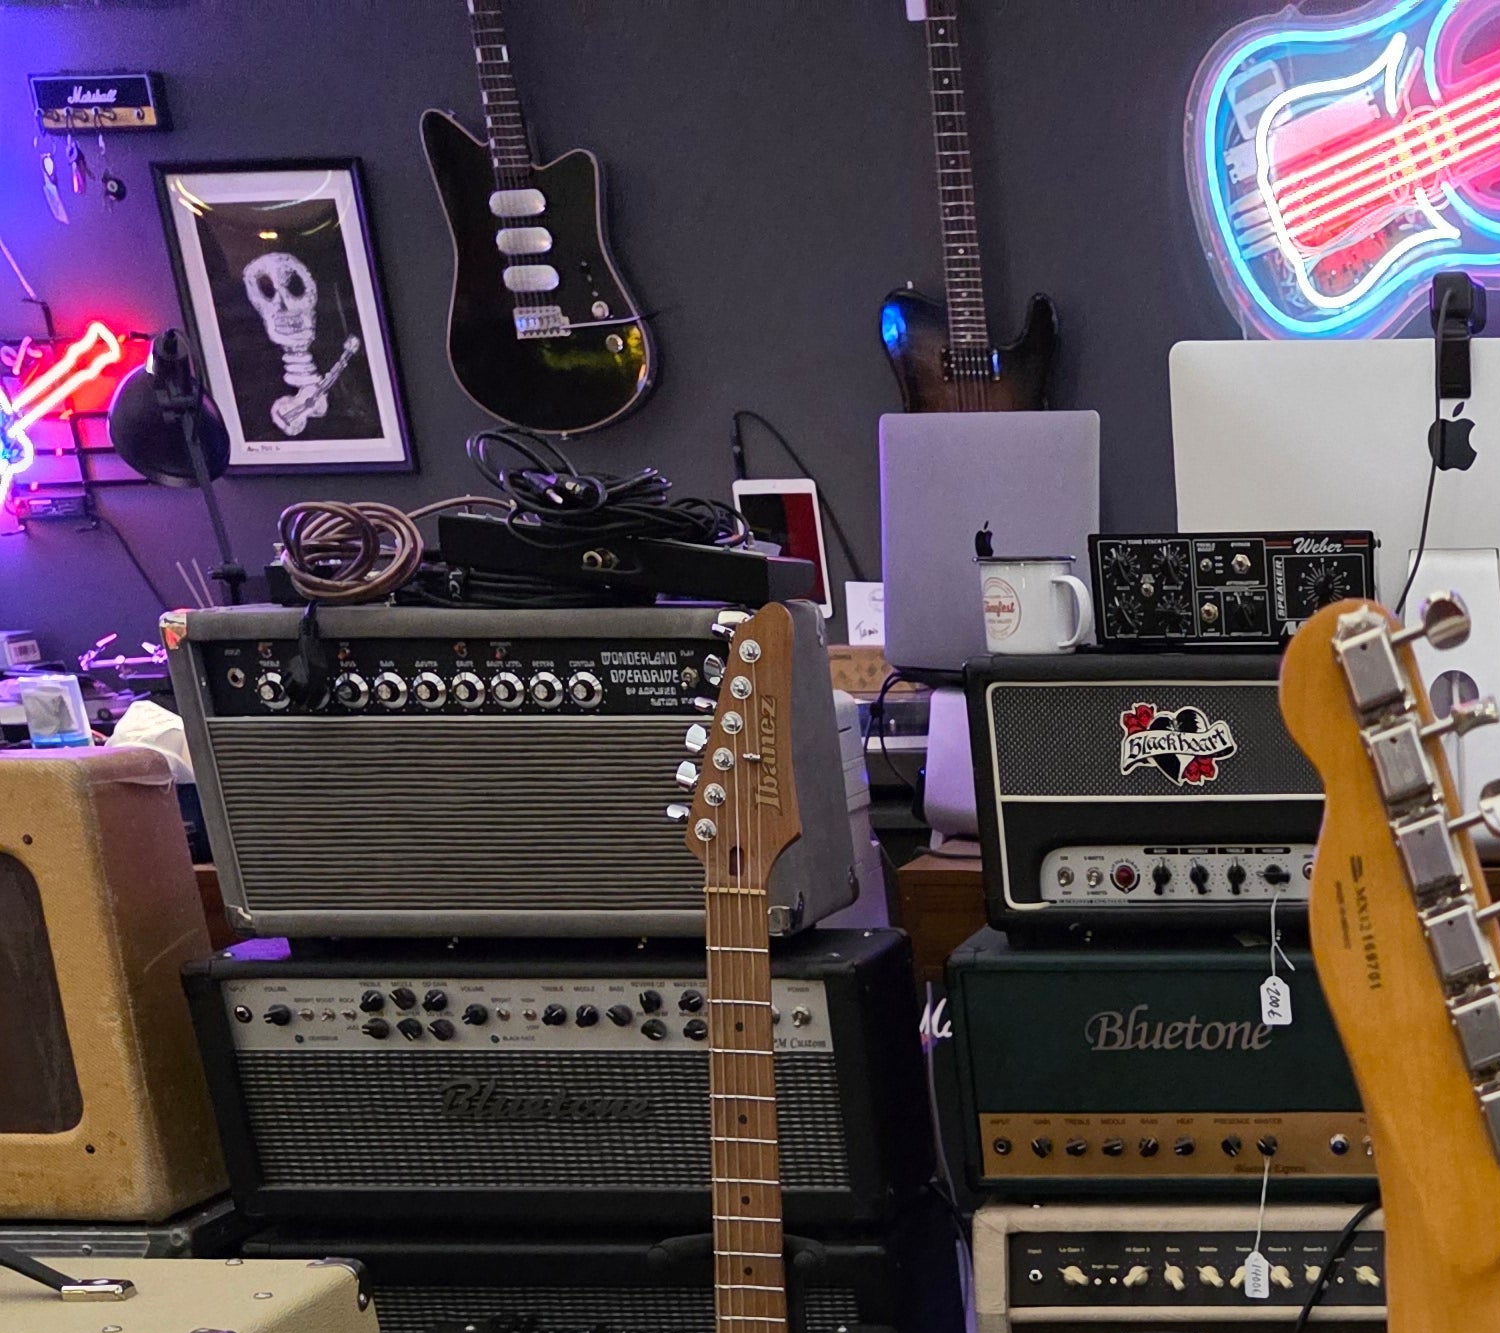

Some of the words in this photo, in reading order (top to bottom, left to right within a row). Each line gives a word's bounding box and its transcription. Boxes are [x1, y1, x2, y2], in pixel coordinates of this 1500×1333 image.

[1293, 537, 1344, 554] Weber
[1275, 560, 1286, 617] SPEAKER
[600, 651, 678, 666] WONDERLAND
[610, 669, 680, 683] OVERDRIVE
[754, 694, 783, 817] Ibanez
[1128, 728, 1227, 759] Blackheart
[1084, 1003, 1273, 1051] Bluetone
[437, 1077, 652, 1120] Bluetone
